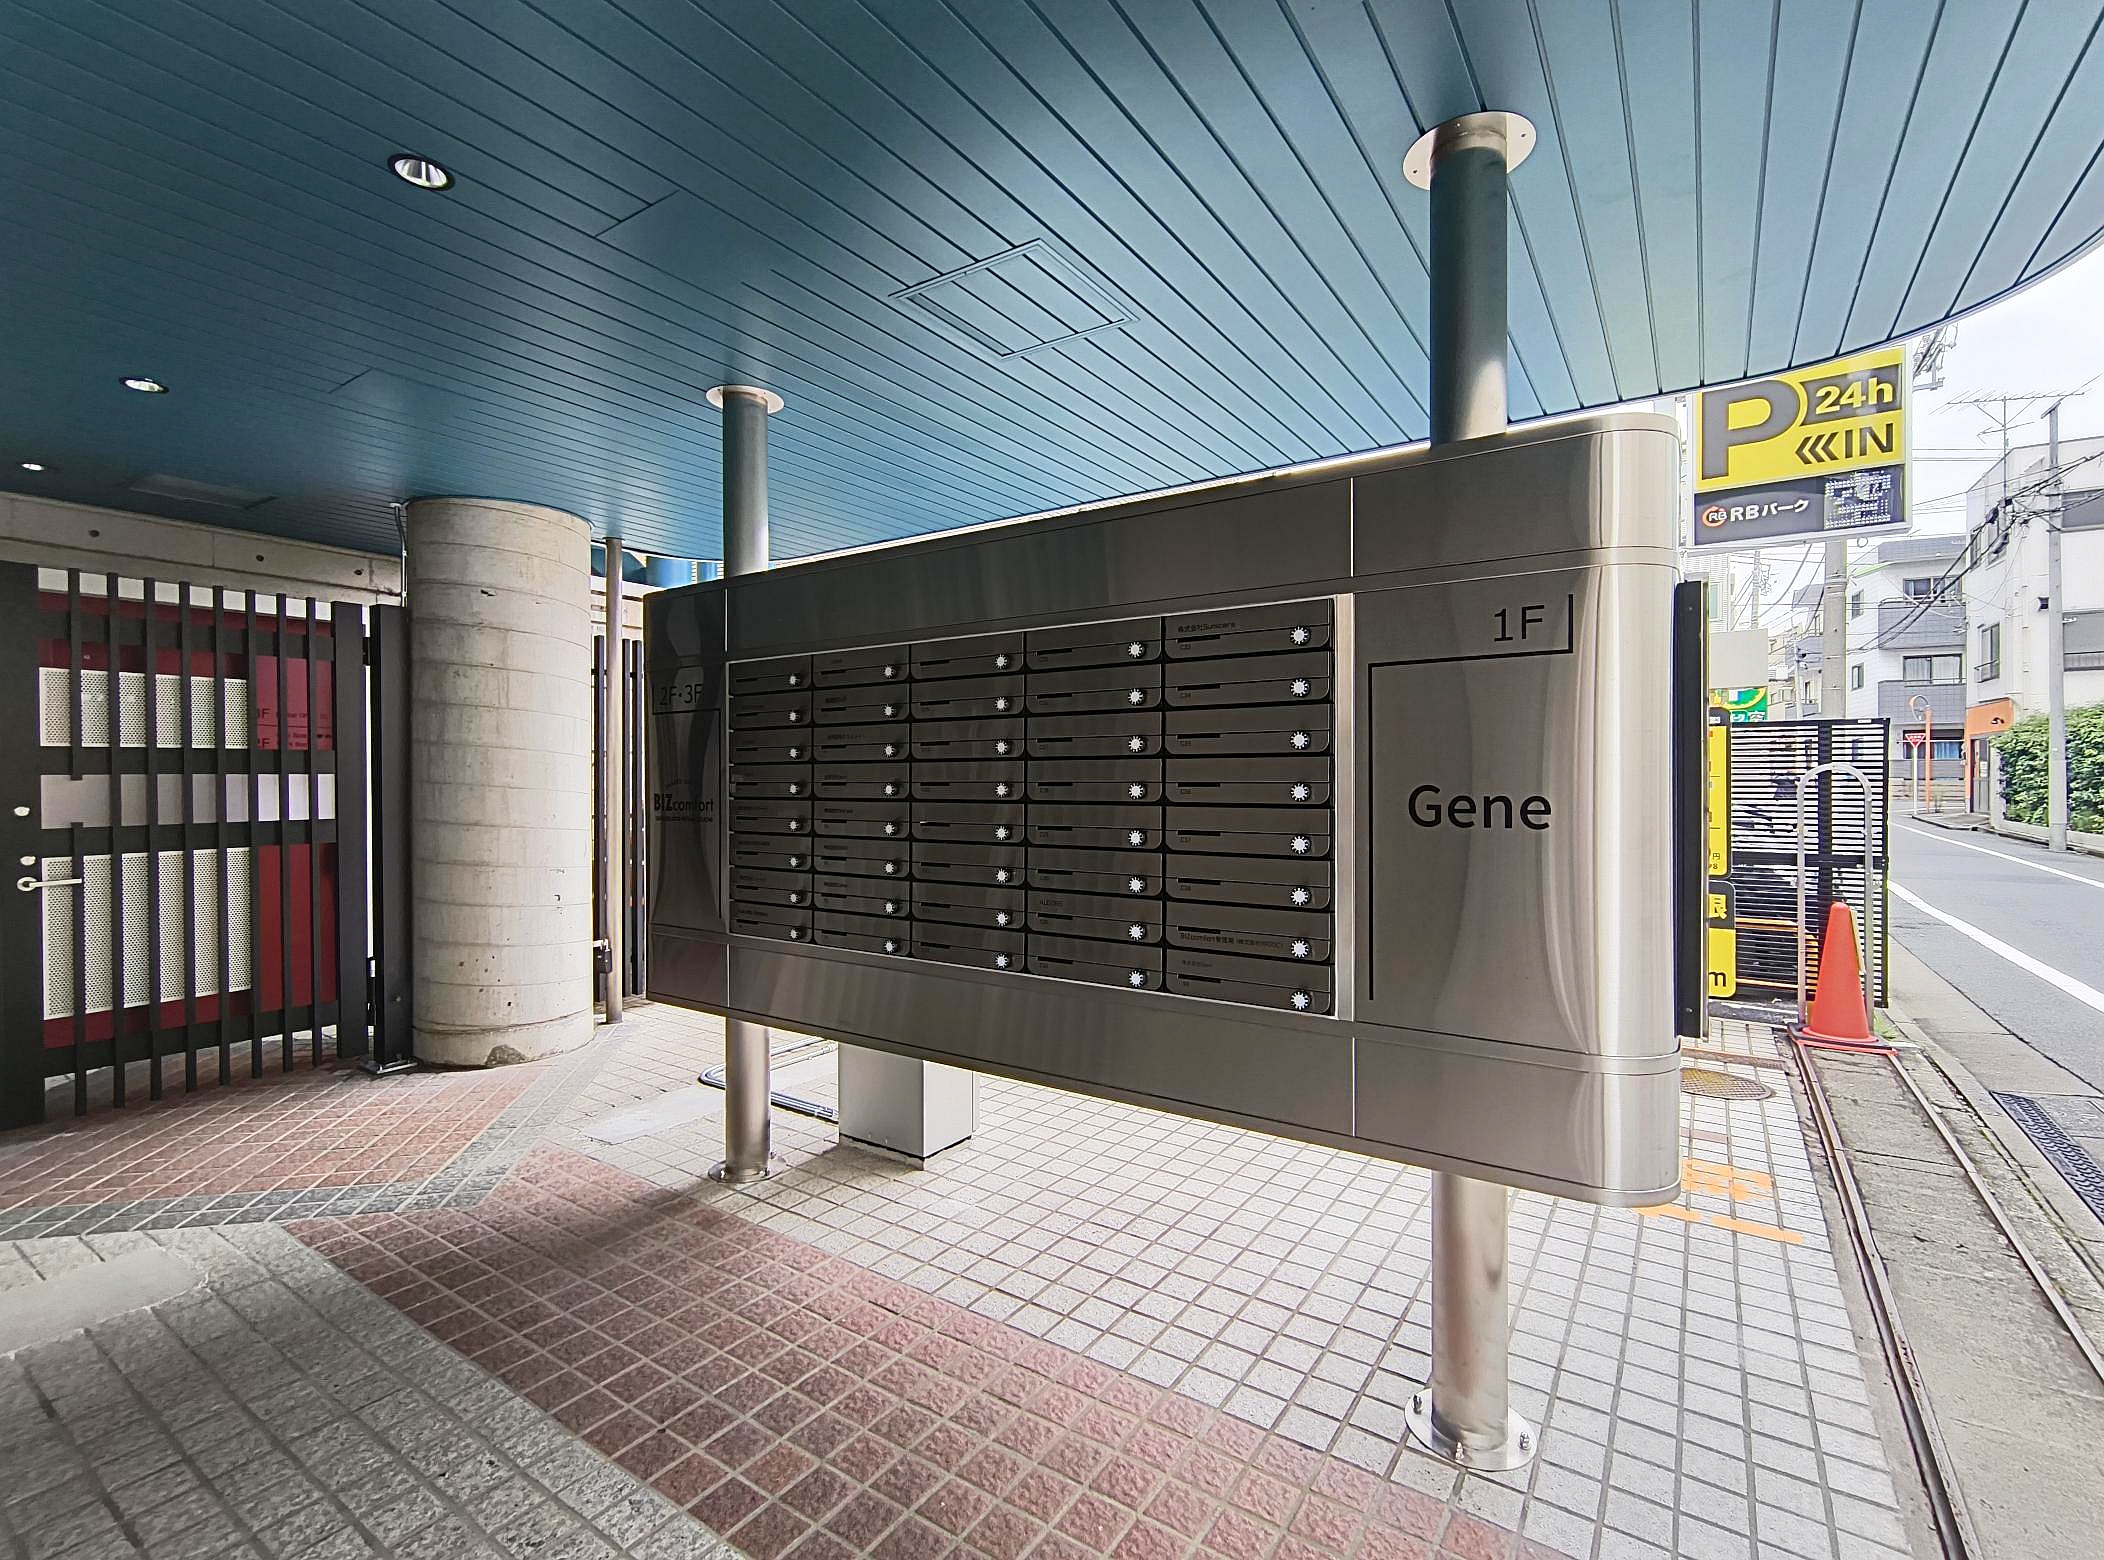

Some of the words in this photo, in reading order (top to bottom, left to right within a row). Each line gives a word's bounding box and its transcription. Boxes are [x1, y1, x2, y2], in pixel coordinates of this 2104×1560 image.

[1814, 377, 1893, 415] 24h
[1701, 379, 1800, 480] P
[1845, 423, 1894, 458] IN
[1730, 498, 1809, 522] RBパーク
[1493, 604, 1545, 642] 1F
[1408, 784, 1552, 830] Gene
